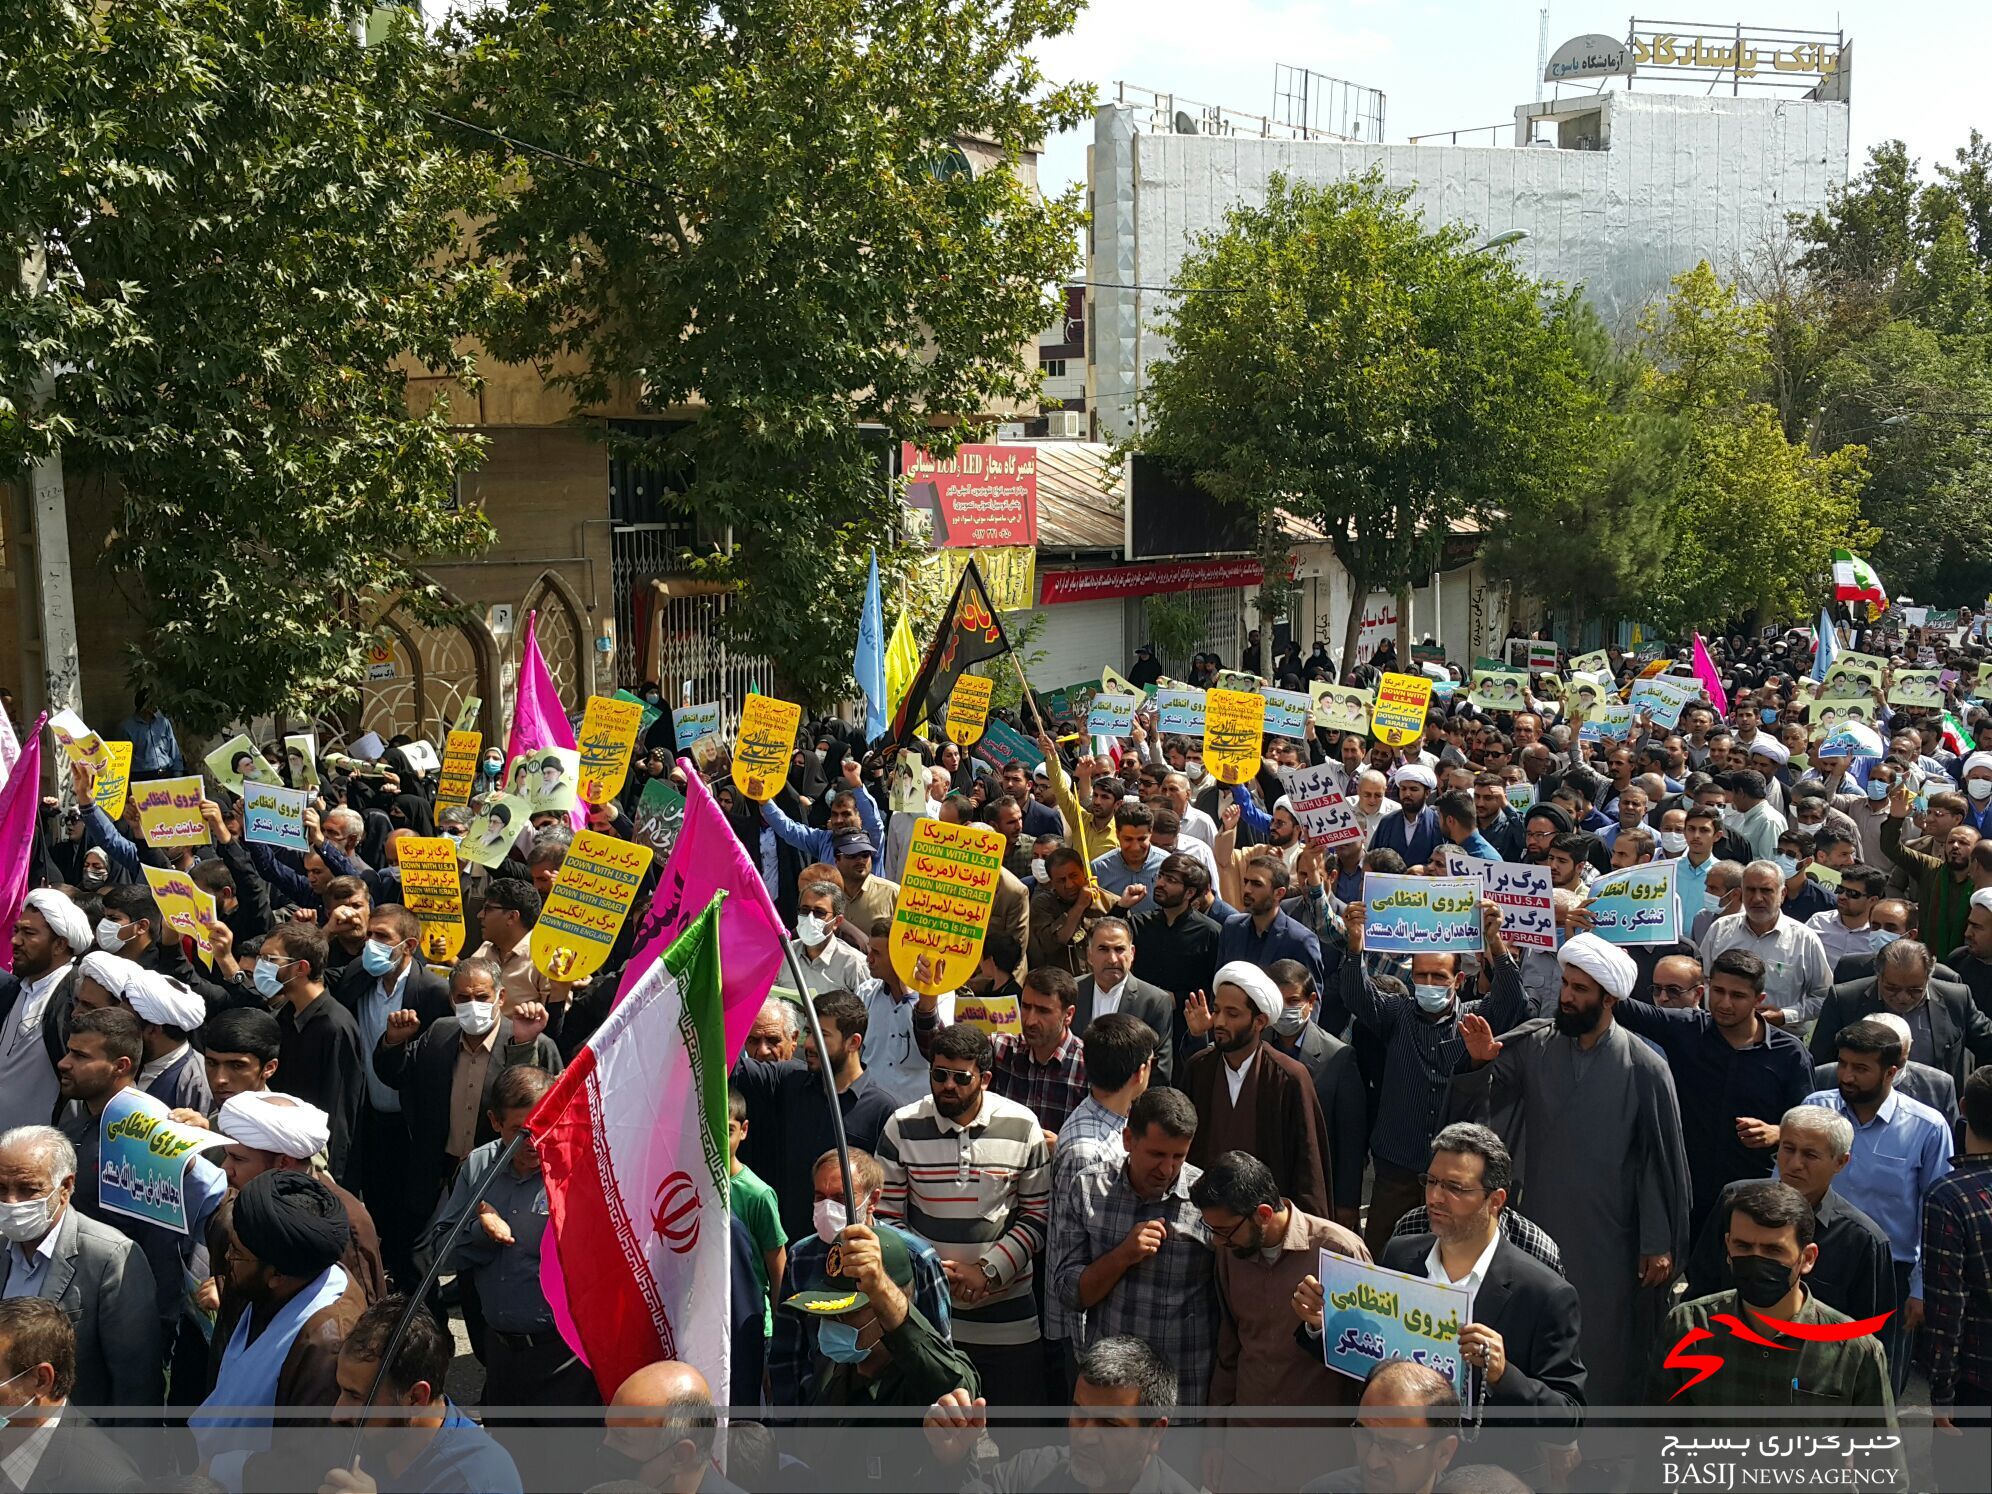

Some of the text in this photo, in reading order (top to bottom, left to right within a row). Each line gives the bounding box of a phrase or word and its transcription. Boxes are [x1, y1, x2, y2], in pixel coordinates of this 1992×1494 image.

[1552, 51, 1624, 76] آزمایشگاه یاسوج
[1634, 33, 1839, 82] بانک پاسارگاد
[937, 456, 956, 474] LCD
[963, 454, 982, 474] LED
[984, 454, 1002, 481] مجاز
[1385, 678, 1405, 687] آمریکا
[1413, 684, 1428, 692] مرگ
[1162, 698, 1189, 709] انتظامی
[1378, 702, 1401, 711] اسرائیل
[1636, 687, 1681, 706] نیروی انتظامی
[1113, 704, 1131, 715] نیروی
[1285, 702, 1306, 713] نیروی
[1089, 718, 1105, 727] تشکر
[1163, 715, 1182, 725] تشکر
[1385, 720, 1408, 728] ISRAEL
[1611, 712, 1630, 725] نیروی
[1300, 781, 1309, 800] بر
[1307, 772, 1333, 795] مرگ
[138, 787, 200, 811] نیروی انتظامی
[248, 796, 299, 818] نیروی انتظامی
[1315, 796, 1338, 807] U.S.A
[150, 820, 205, 839] حمایت میکنیم
[252, 818, 272, 831] تشکر
[1316, 808, 1351, 834] مرگ بر
[923, 823, 999, 854] مرگ بر امریکا
[1326, 832, 1354, 843] ISRAEL
[402, 845, 425, 858] امریکا
[427, 850, 433, 858] بر
[435, 845, 450, 859] مرگ
[578, 839, 640, 868] مرگ بر امریکا
[915, 842, 995, 868] DOWN WITH U.S.A
[441, 873, 455, 886] مرگ
[568, 858, 635, 884] DOWN WITH U.S.A
[916, 857, 991, 886] الموت لامریکا
[562, 871, 628, 899] مرگ بر اسرائیل
[906, 875, 988, 902] DOWN WITH ISRAEL
[1494, 874, 1509, 891] بر
[1512, 870, 1547, 895] مرگ
[1631, 877, 1667, 899] نیروی
[555, 886, 624, 912] DOWN WITH ISRAEL
[906, 892, 985, 922] الموت لاسرائیل
[1372, 890, 1474, 912] نیروی انتظامی
[1485, 891, 1544, 907] WITH U.S.A
[547, 904, 615, 930] مرگ بر انگلیس
[905, 911, 976, 936] Victory to Islam
[1502, 911, 1551, 932] مرگ بر
[1590, 909, 1664, 930] تشکر، تشک
[541, 915, 612, 941] DOWN WITH ENGLAND
[1395, 919, 1408, 936] الله
[1409, 923, 1428, 941] سبیل
[1430, 922, 1442, 942] فی
[1444, 922, 1479, 942] مجاهدان
[902, 929, 940, 948] للاسلام
[1510, 933, 1546, 945] ISRAEL
[989, 1006, 1016, 1024] نیروی
[108, 1110, 160, 1141] انتظامی
[131, 1164, 145, 1200] سبیل
[1331, 1283, 1458, 1341] نیروی انتظامی
[1336, 1329, 1385, 1361] تشکر
